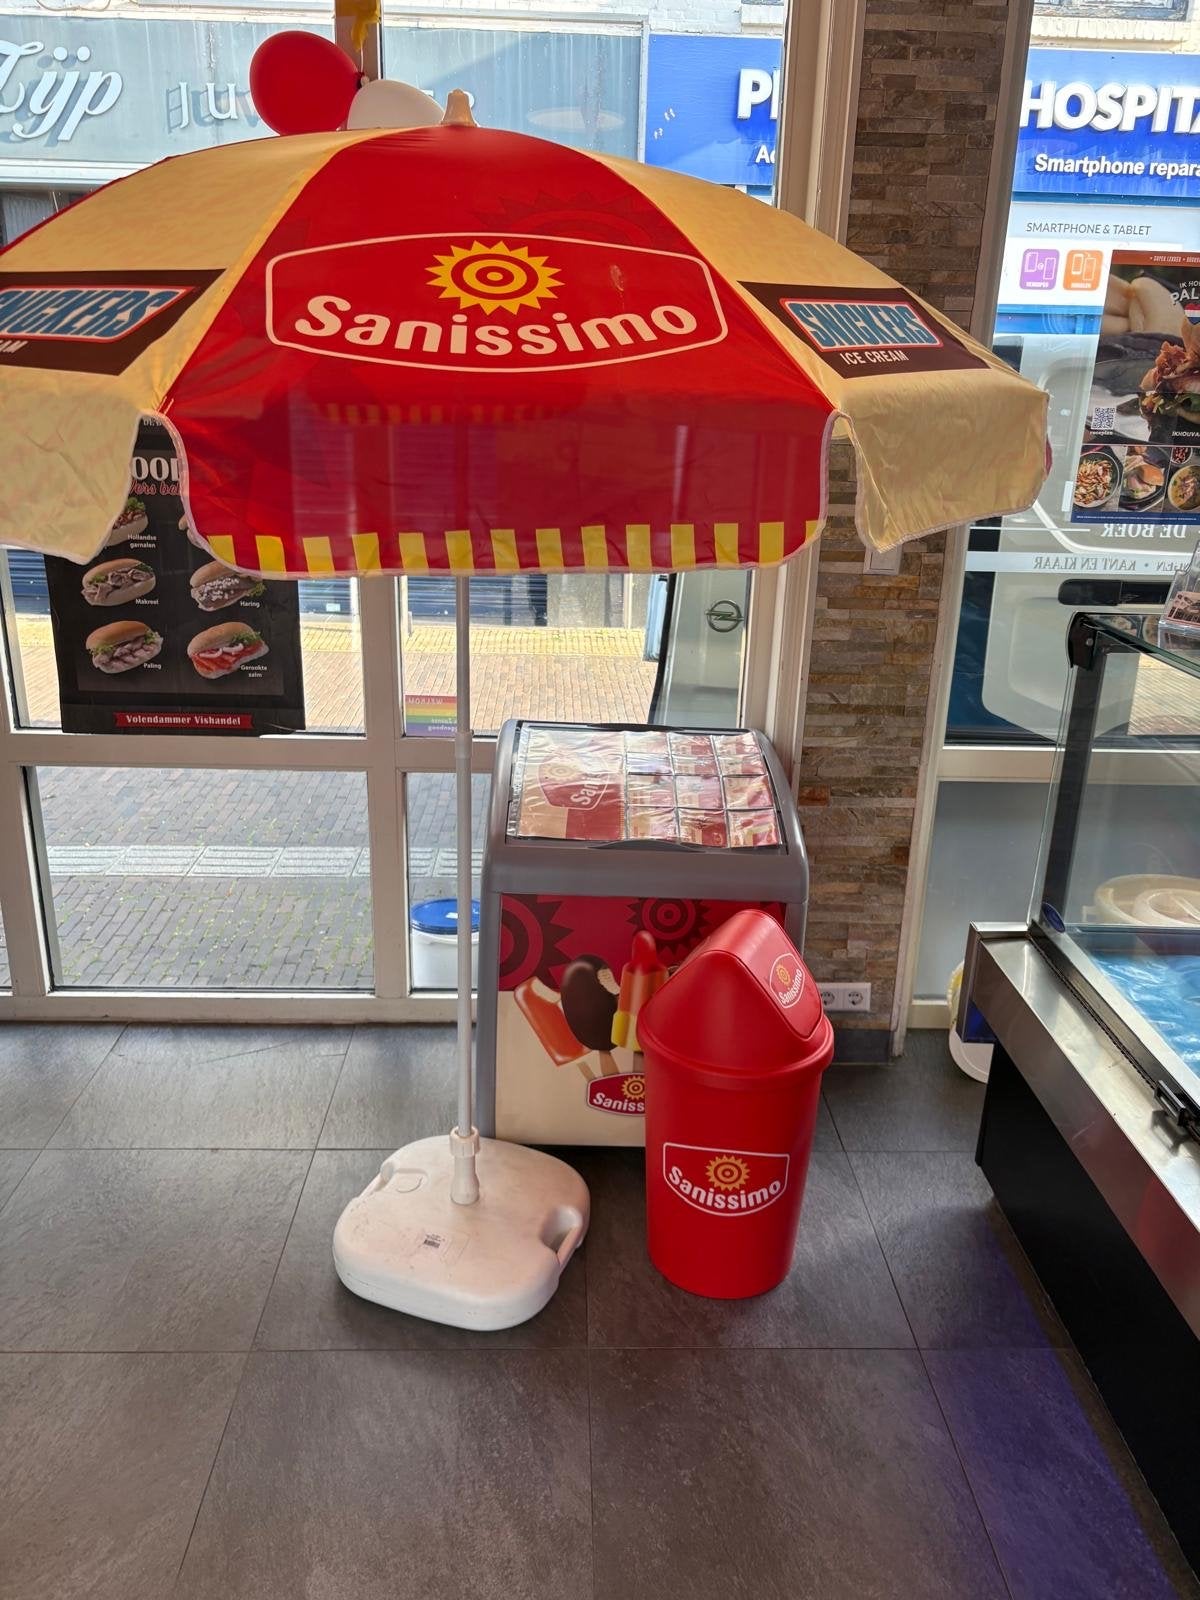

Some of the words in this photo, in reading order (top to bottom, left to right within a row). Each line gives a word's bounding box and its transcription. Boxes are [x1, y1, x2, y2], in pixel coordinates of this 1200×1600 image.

[1019, 80, 1200, 134] HOSPIT
[1035, 153, 1144, 177] Smartphone
[1026, 222, 1101, 234] SMARTPHONE
[1103, 224, 1110, 234] &
[1112, 224, 1152, 236] TABLET
[295, 295, 698, 355] Sanissimo
[788, 302, 938, 347] SNICKERS
[840, 352, 866, 365] ICE
[865, 350, 910, 363] CREAM
[240, 600, 260, 608] Haring
[126, 714, 191, 725] Volendammer
[194, 715, 241, 726] Vishandel
[778, 968, 803, 1005] Sanissimo
[592, 1092, 645, 1112] Saniss
[669, 1165, 781, 1210] Sanissimo
